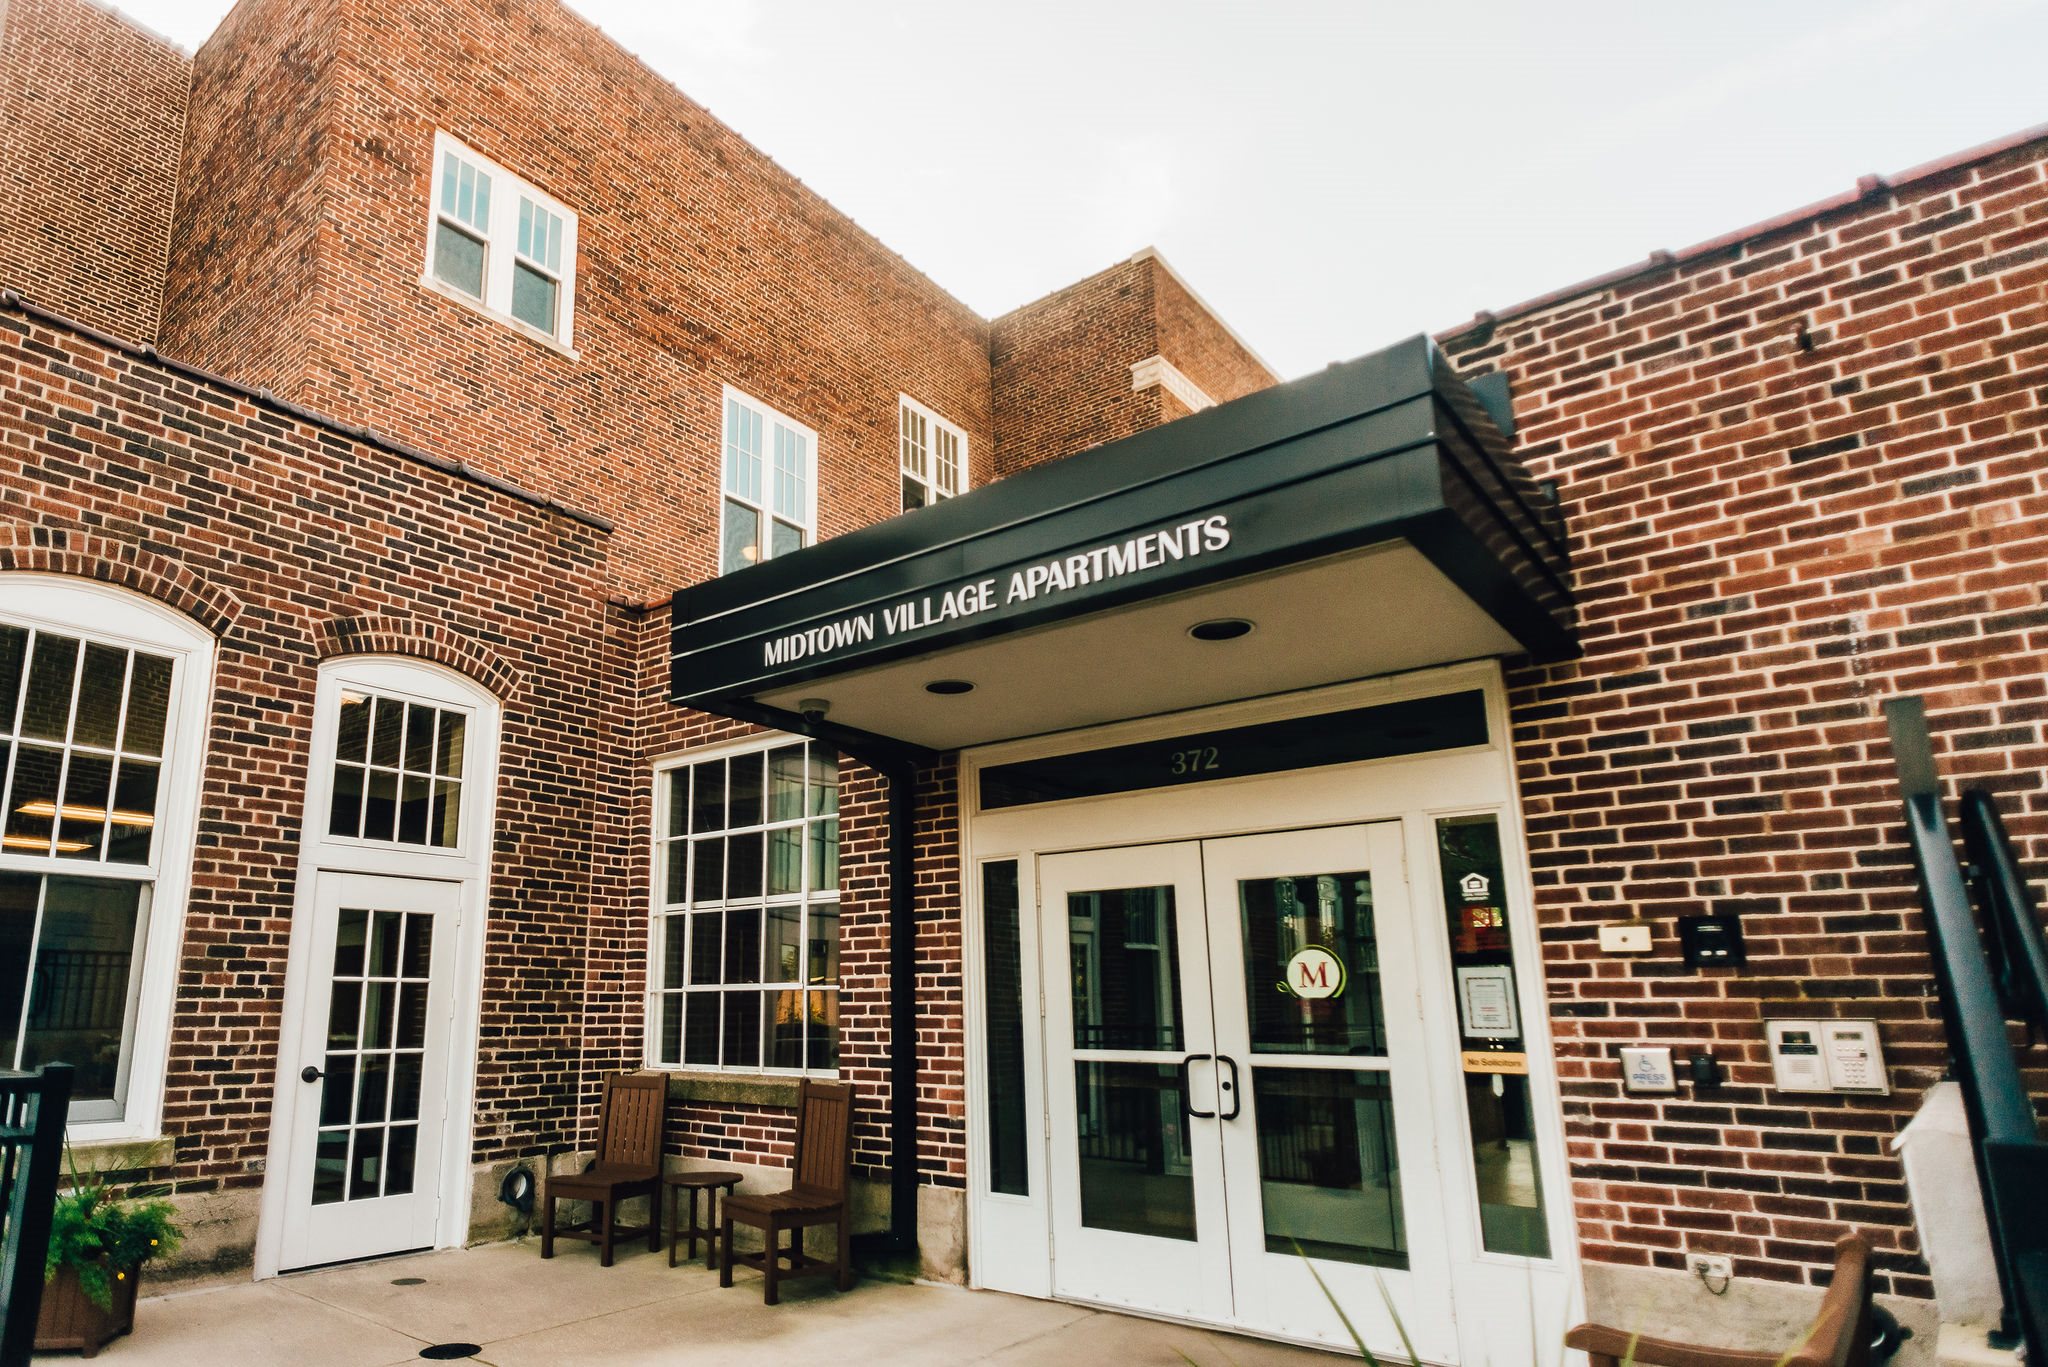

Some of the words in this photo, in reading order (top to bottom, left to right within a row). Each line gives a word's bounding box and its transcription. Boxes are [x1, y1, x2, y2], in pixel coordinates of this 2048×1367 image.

[764, 612, 874, 667] MIDTOWN
[883, 578, 997, 636] VILLAGE
[1006, 514, 1231, 604] APARTMENTS
[1171, 746, 1219, 775] 372
[1298, 961, 1329, 988] M
[1467, 1058, 1480, 1066] No
[1481, 1058, 1522, 1067] Solicitors
